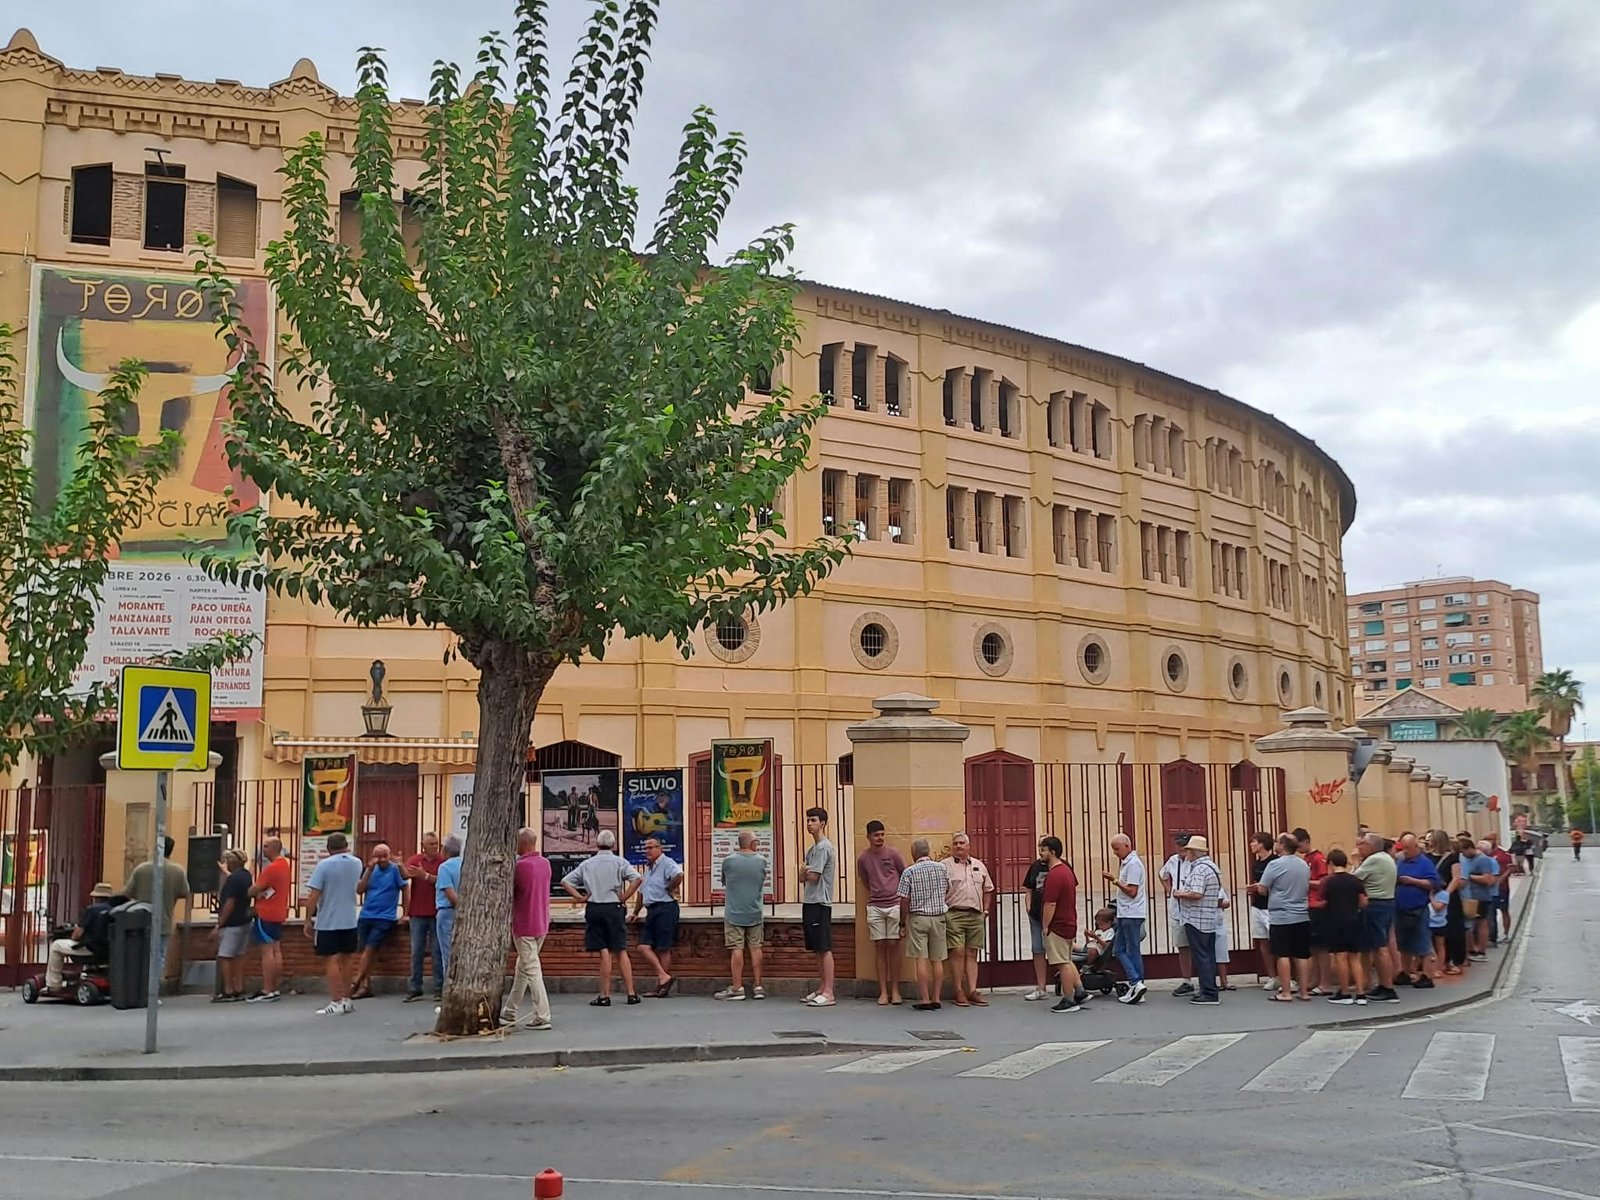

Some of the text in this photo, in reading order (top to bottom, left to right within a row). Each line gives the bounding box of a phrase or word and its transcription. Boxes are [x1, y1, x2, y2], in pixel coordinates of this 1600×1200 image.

[104, 571, 134, 580] BRE
[139, 572, 171, 581] 2026
[118, 602, 165, 611] MORANTE
[191, 602, 252, 612] PACO UREÑA
[109, 614, 172, 624] MANZANARES
[190, 616, 252, 625] JUAN ORTEGA
[111, 626, 170, 636] TALAVANTE
[195, 628, 222, 636] ROCA
[103, 656, 132, 665] EMILIO
[135, 656, 147, 665] DE
[77, 664, 95, 672] ANO
[214, 668, 251, 677] VENTURA
[213, 681, 251, 691] FERNANDES
[628, 777, 677, 792] SILVIO
[454, 793, 474, 808] ORO
